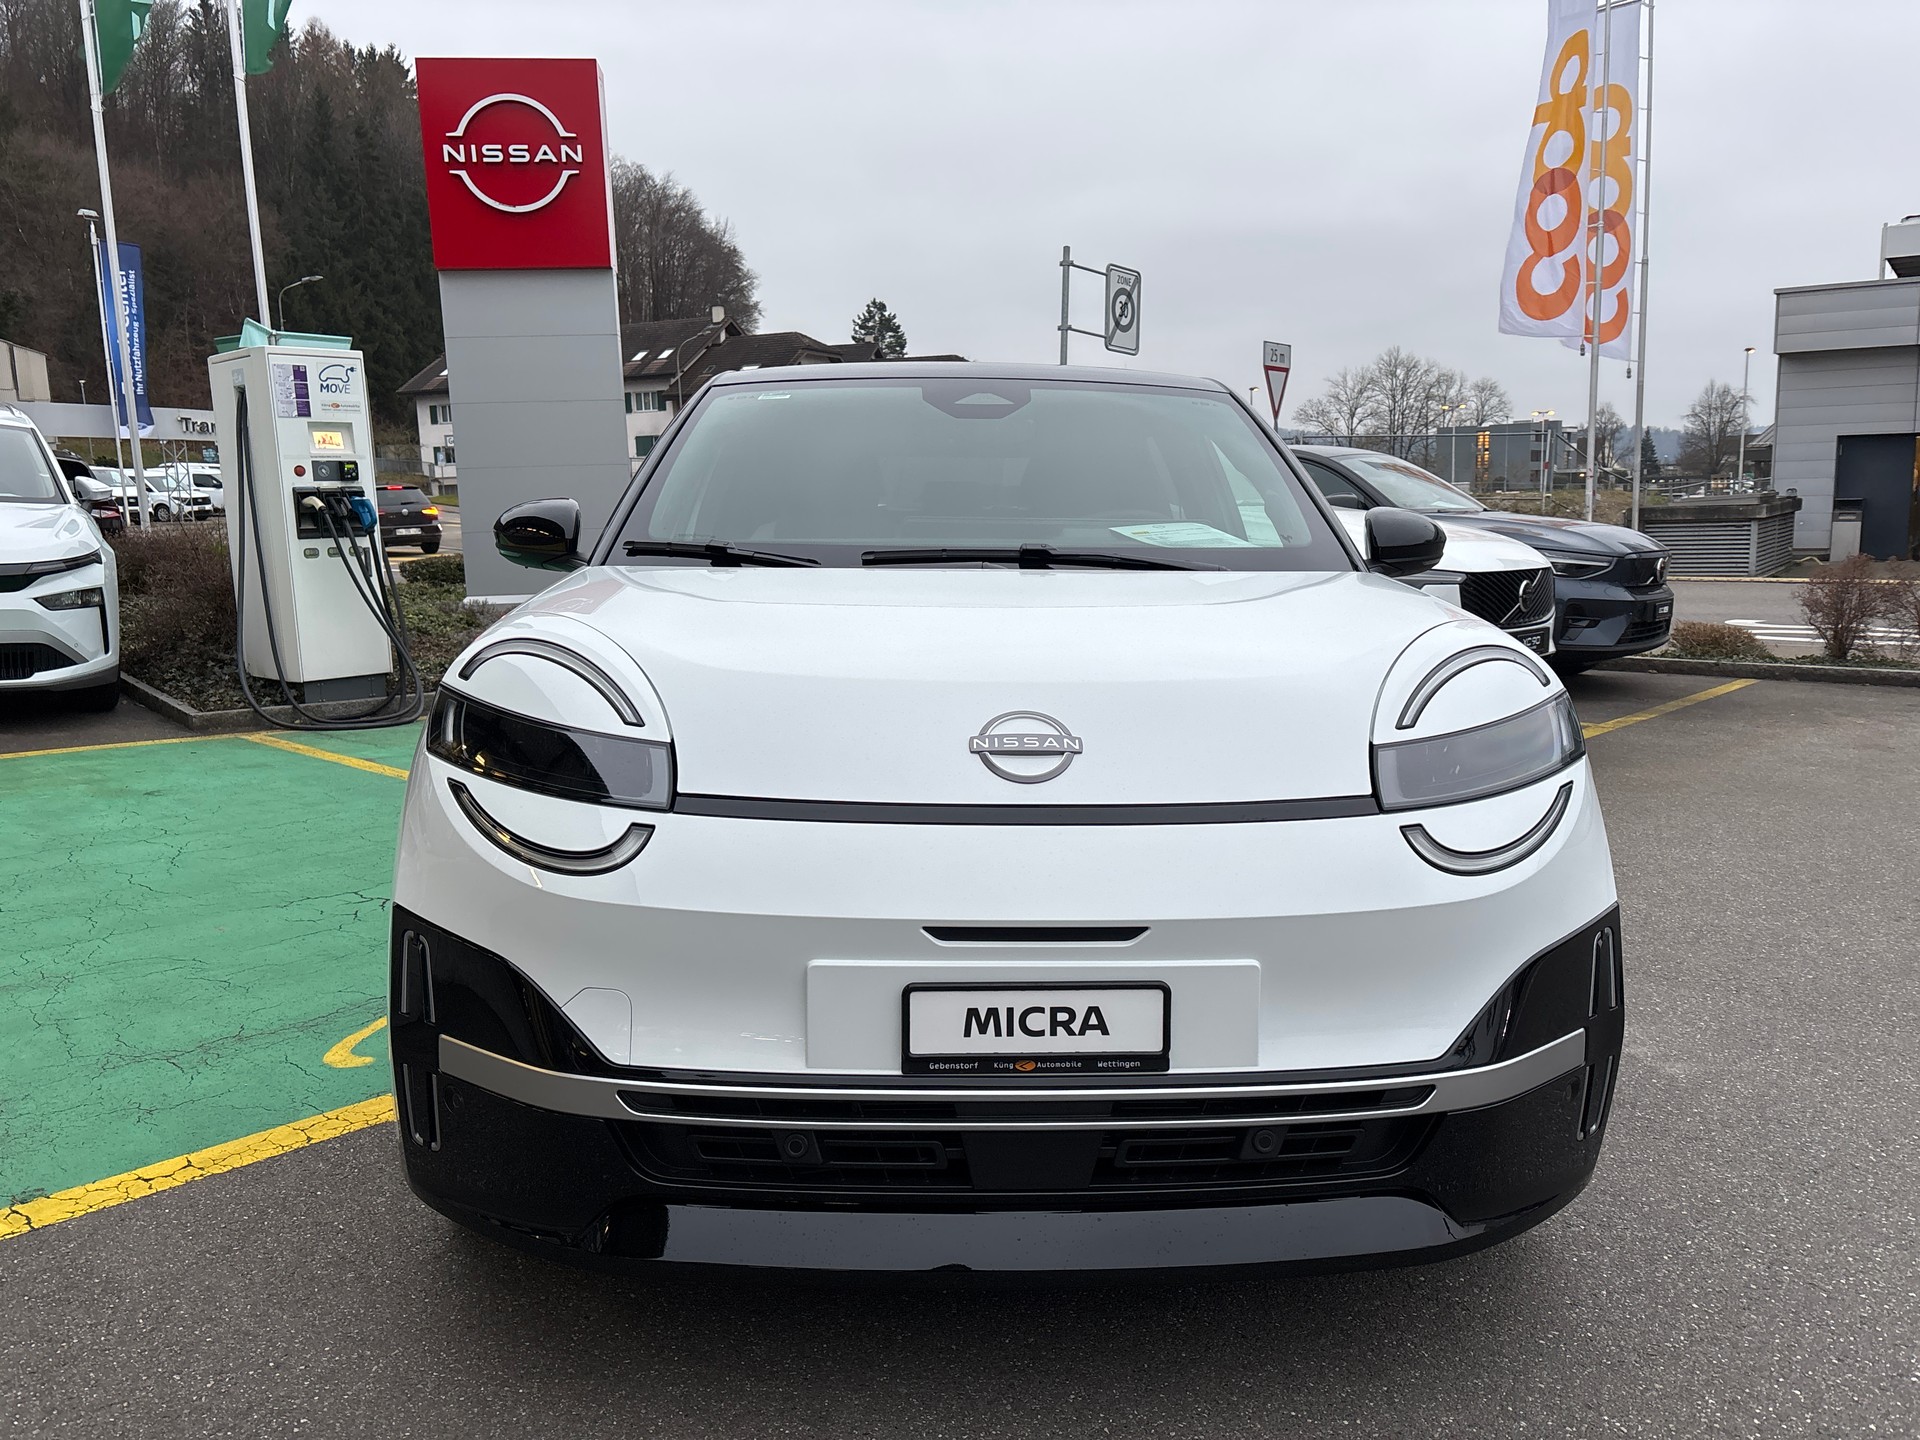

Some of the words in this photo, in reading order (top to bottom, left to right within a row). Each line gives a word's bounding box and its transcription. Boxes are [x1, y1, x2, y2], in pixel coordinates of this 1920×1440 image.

[442, 144, 583, 163] NISSAN
[1516, 29, 1589, 321] coop
[1116, 274, 1132, 287] ZONE
[1118, 301, 1129, 319] 30
[131, 321, 143, 382] Nutzfahrzeug
[1270, 348, 1278, 362] 25
[135, 382, 145, 395] Ihr
[320, 383, 351, 394] MOVE
[973, 737, 1080, 749] NISSAN
[963, 1005, 1110, 1038] MICRA
[929, 1061, 979, 1070] Gebenstorf
[993, 1061, 1014, 1070] Küng
[1036, 1060, 1082, 1069] Automobile
[1097, 1059, 1141, 1069] Wettingen
